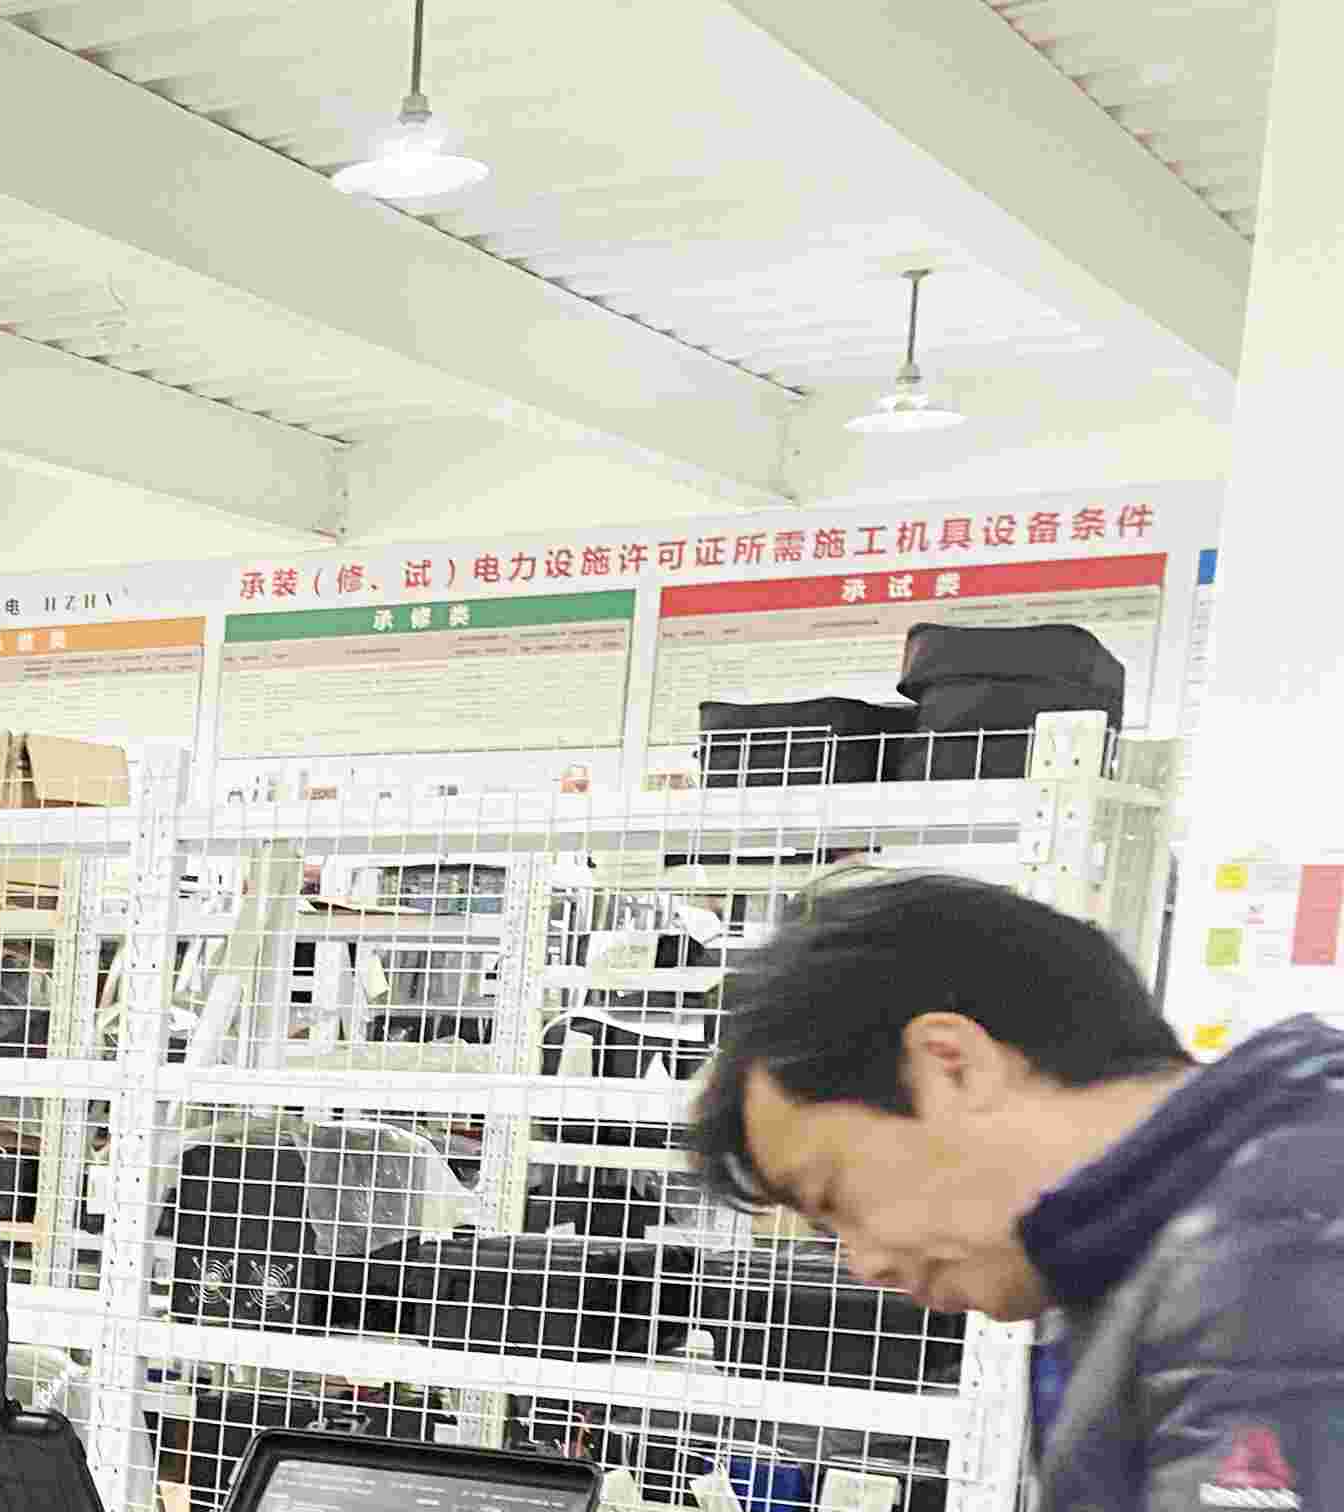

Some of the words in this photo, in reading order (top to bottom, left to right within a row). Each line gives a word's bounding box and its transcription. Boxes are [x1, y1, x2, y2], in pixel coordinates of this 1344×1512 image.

[840, 572, 961, 602] 承试类
[373, 604, 471, 631] 承修类
